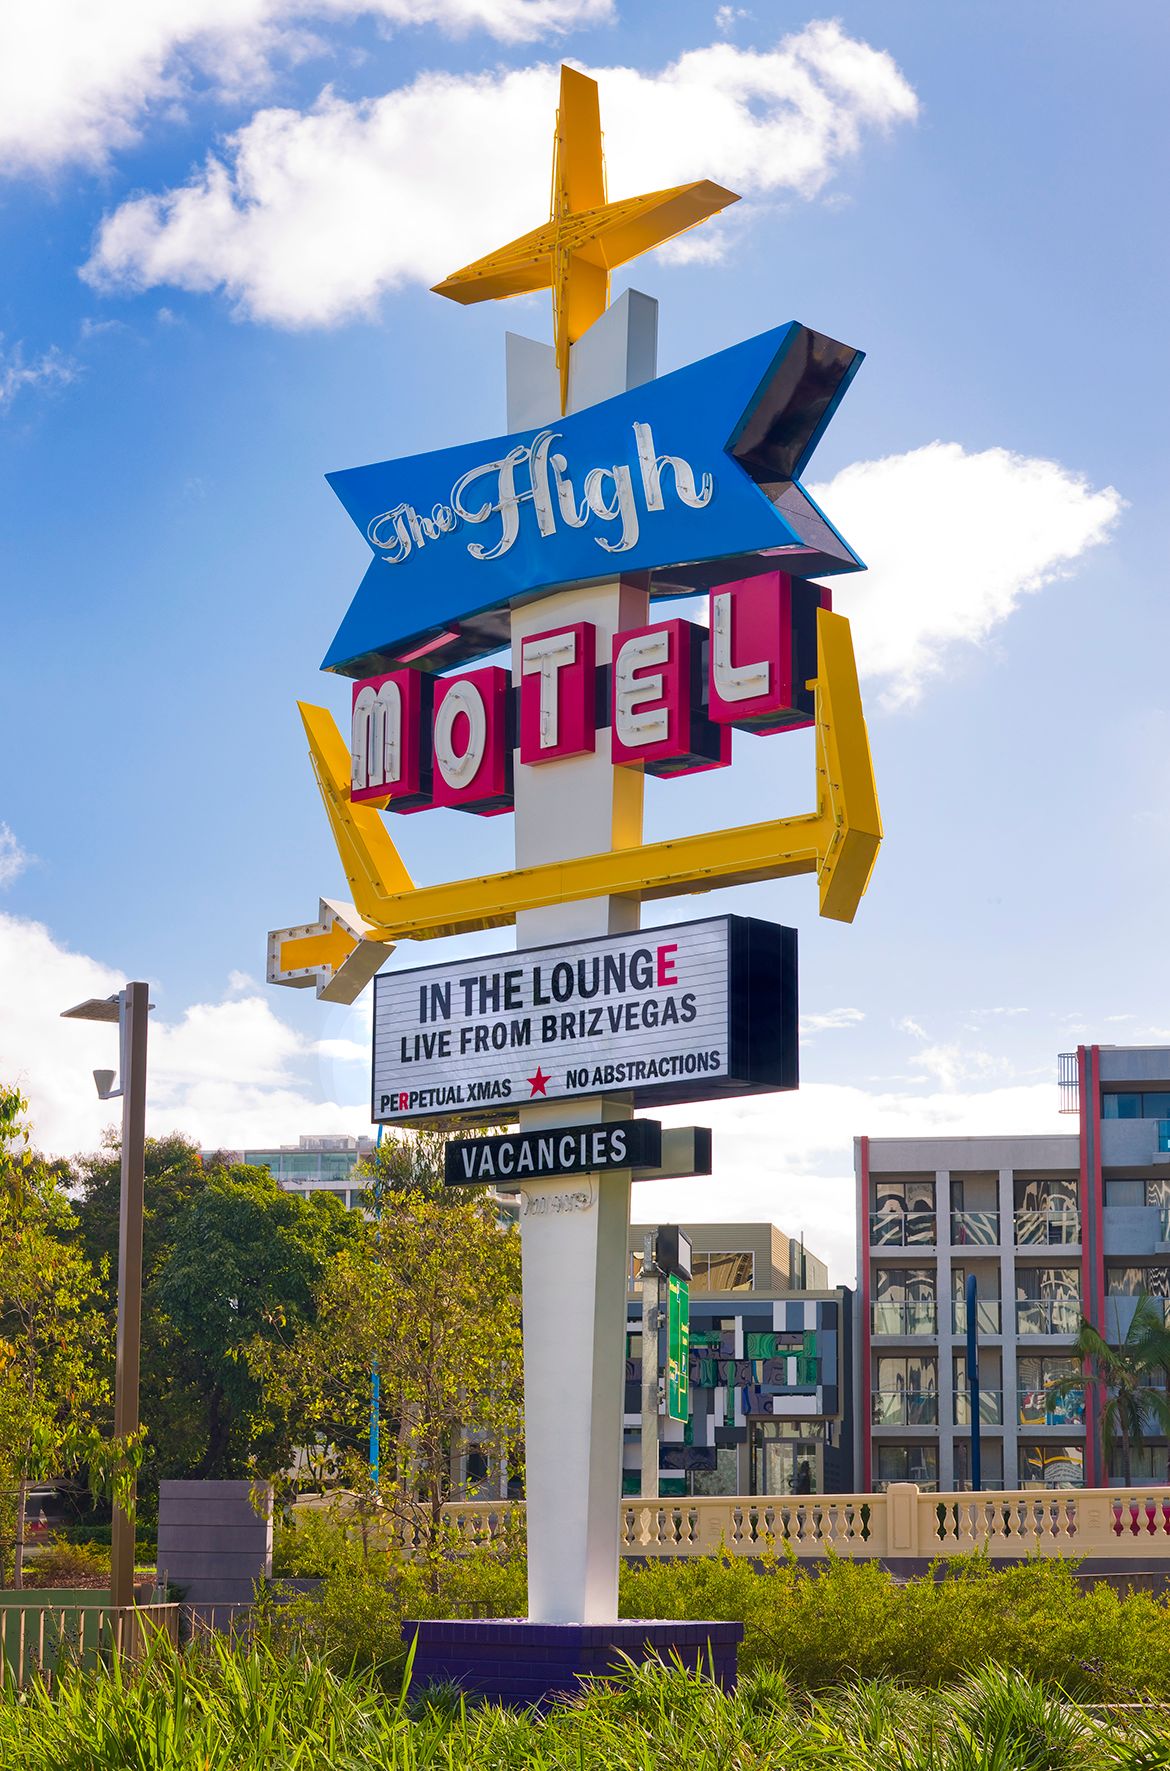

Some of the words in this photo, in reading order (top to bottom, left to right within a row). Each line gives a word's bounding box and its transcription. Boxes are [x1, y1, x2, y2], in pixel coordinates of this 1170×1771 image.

[367, 503, 457, 564] The
[450, 421, 713, 561] High
[351, 592, 770, 791] MOTEL
[419, 981, 450, 1024] IN
[459, 969, 523, 1017] THE
[533, 943, 678, 1006] LOUNGE
[401, 1030, 451, 1063] LIVE
[460, 1018, 531, 1055] FROM
[541, 993, 697, 1043] BRIZVEGAS
[380, 1084, 465, 1113] PERPETUAL
[466, 1078, 512, 1102] XMAS
[566, 1067, 588, 1089] NO
[591, 1050, 721, 1085] ABSTRACTIONS
[461, 1129, 627, 1178] VACANCIES
